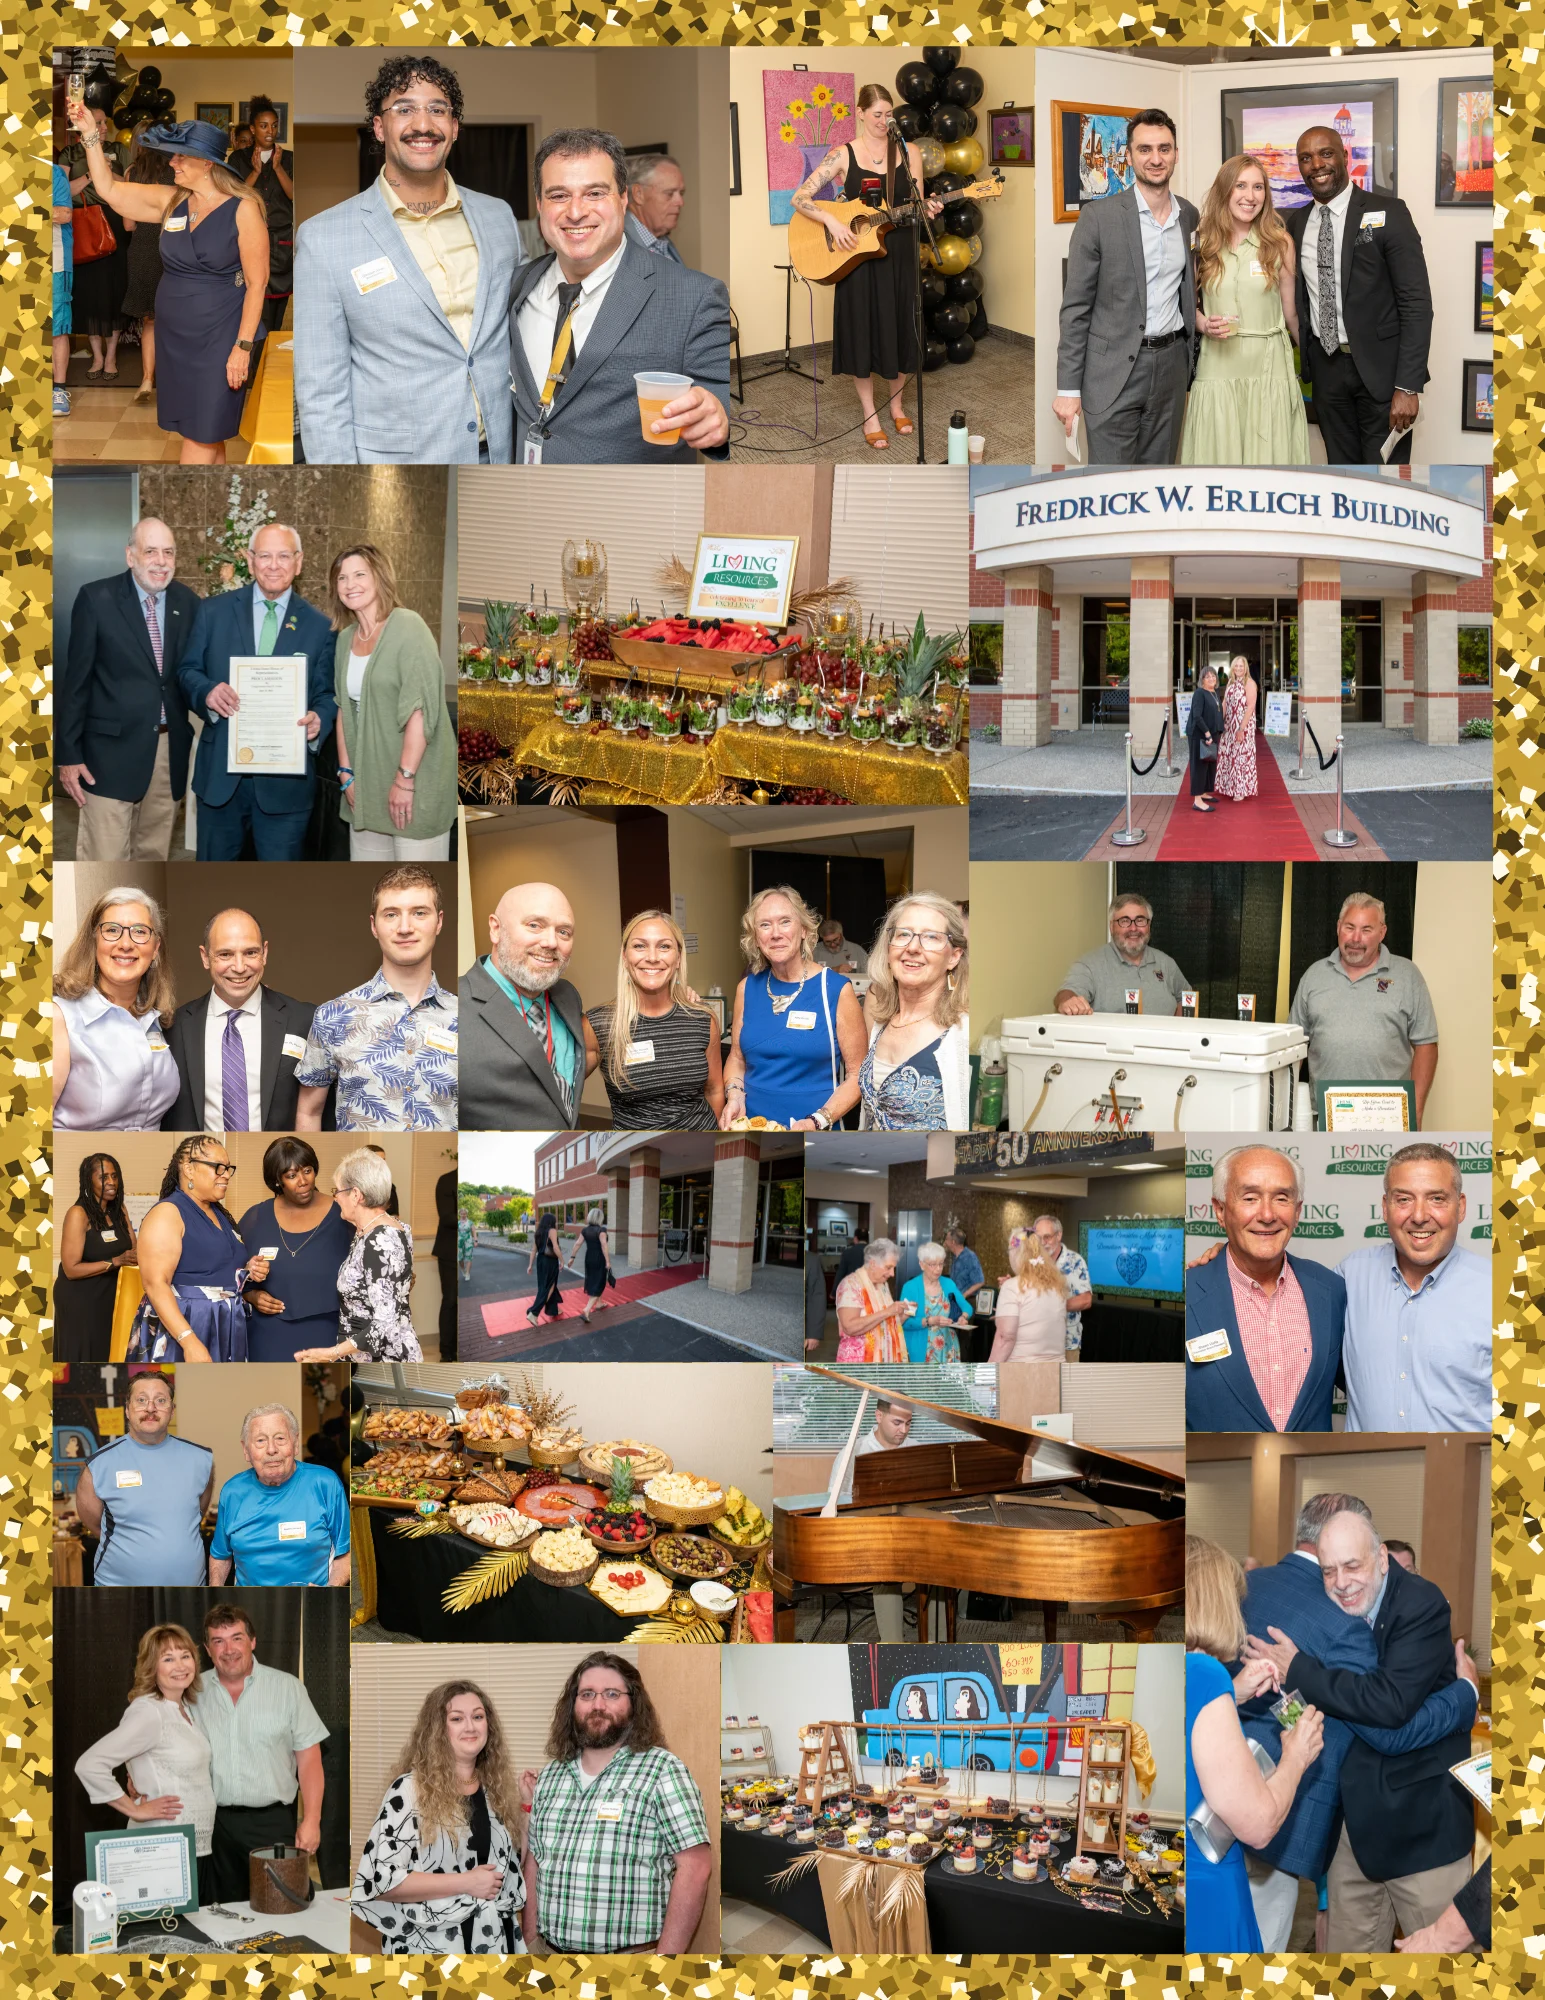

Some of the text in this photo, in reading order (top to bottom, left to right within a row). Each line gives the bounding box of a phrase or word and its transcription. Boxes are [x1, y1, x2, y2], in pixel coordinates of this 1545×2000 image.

[1016, 485, 1450, 537] FREDRICK W. ERLICH BUILDING
[713, 573, 769, 586] RESOURCES
[715, 600, 757, 610] EXCELLENCE
[957, 1139, 994, 1164] HAPPY
[996, 1131, 1029, 1167] 50
[1185, 1149, 1212, 1162] ING
[1303, 1204, 1339, 1220] ING
[1115, 1231, 1139, 1239] Consider
[1140, 1231, 1166, 1240] Making
[1293, 1225, 1335, 1235] OURCES
